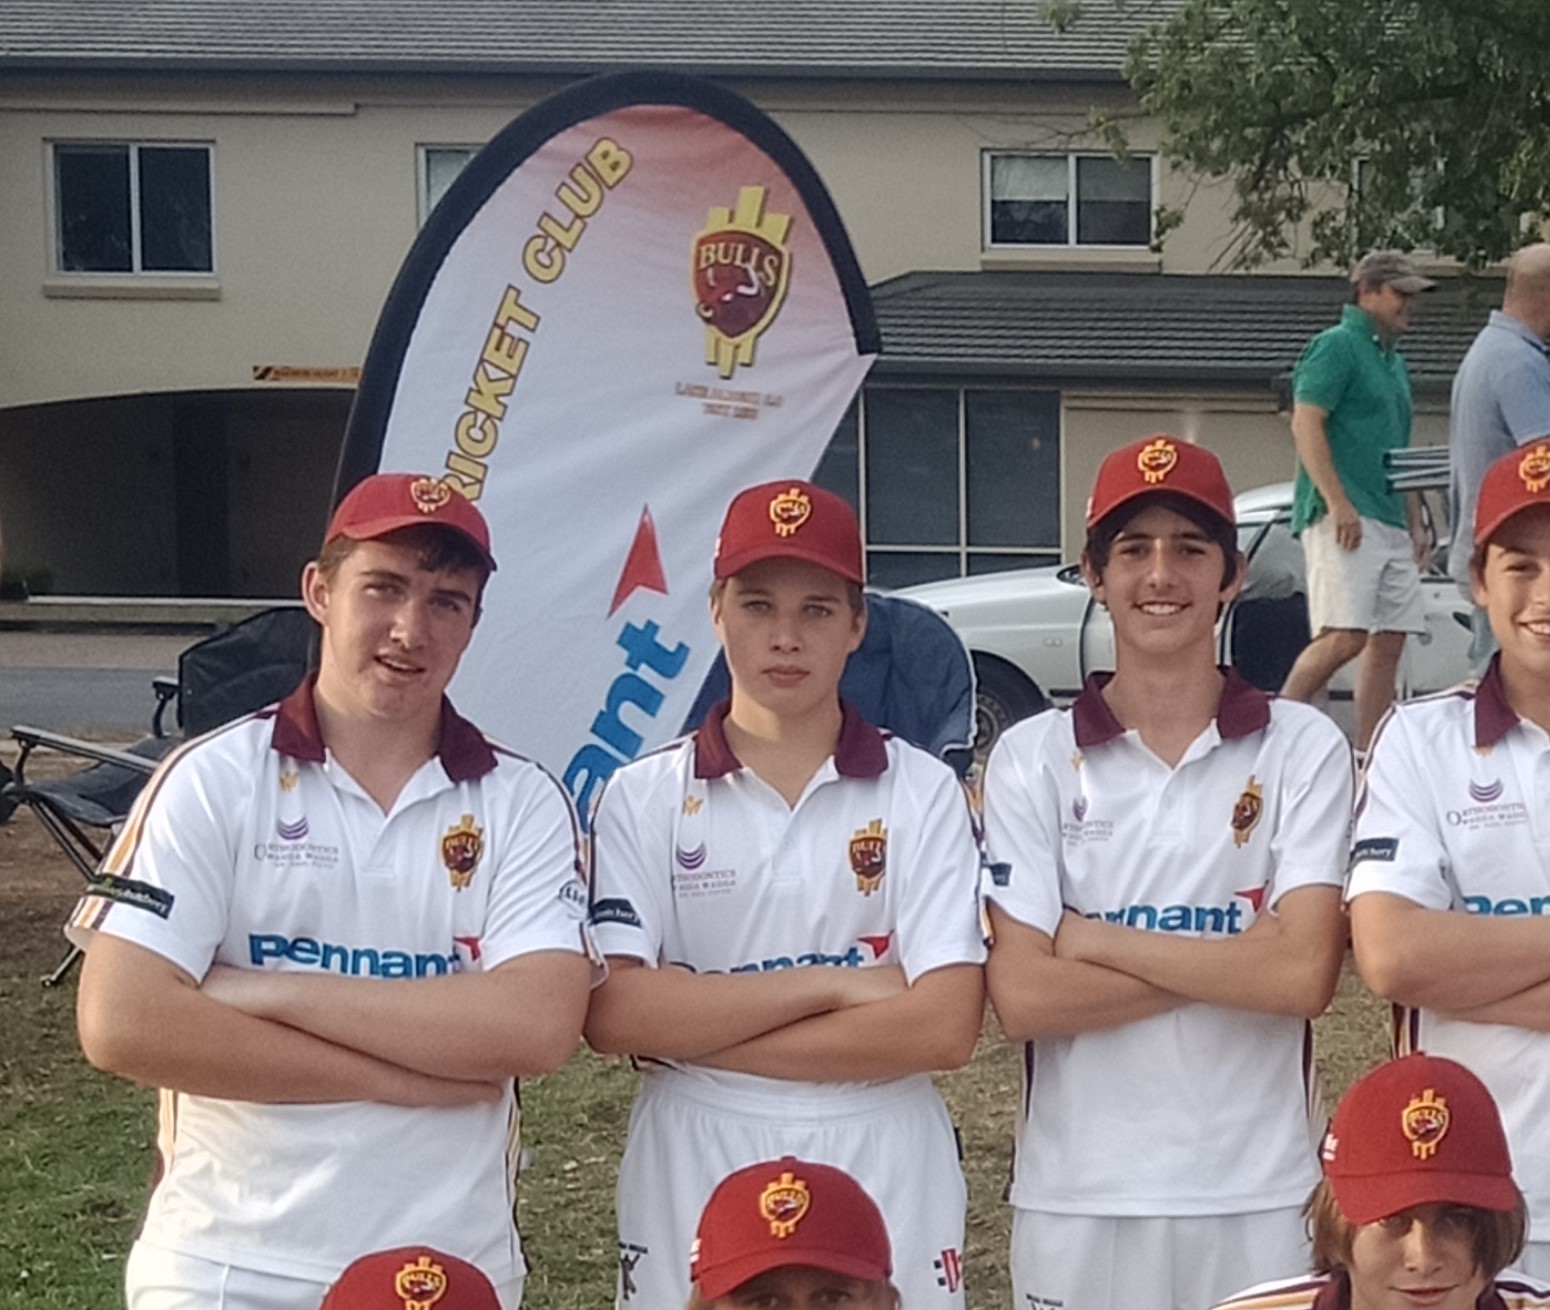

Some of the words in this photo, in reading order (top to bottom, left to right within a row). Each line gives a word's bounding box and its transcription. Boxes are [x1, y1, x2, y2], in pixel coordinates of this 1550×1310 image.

[522, 136, 634, 284] CLUB
[698, 242, 781, 287] BULLS
[562, 618, 691, 834] ant
